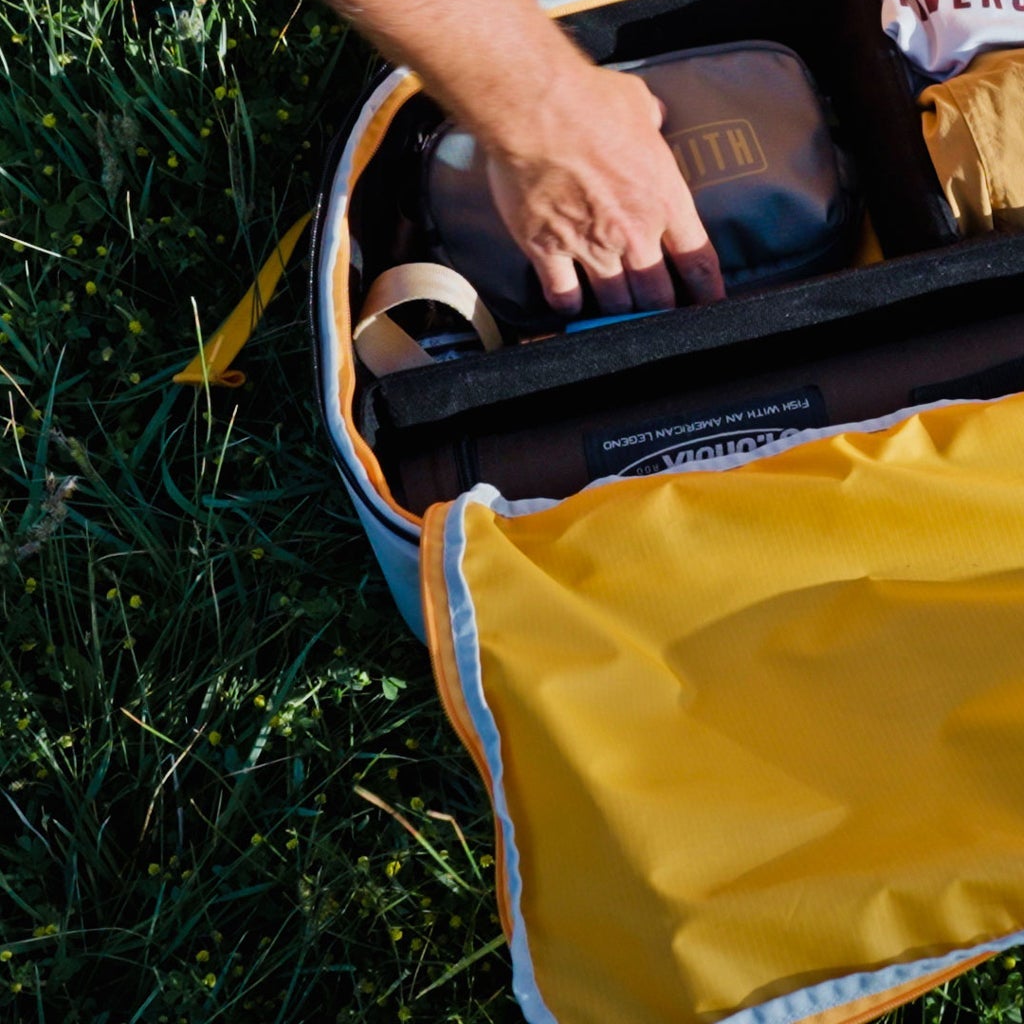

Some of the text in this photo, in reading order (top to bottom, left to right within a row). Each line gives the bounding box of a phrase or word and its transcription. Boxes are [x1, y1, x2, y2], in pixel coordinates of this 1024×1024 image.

[602, 398, 810, 451] FISH WITH AN AMERICAN LEGEND
